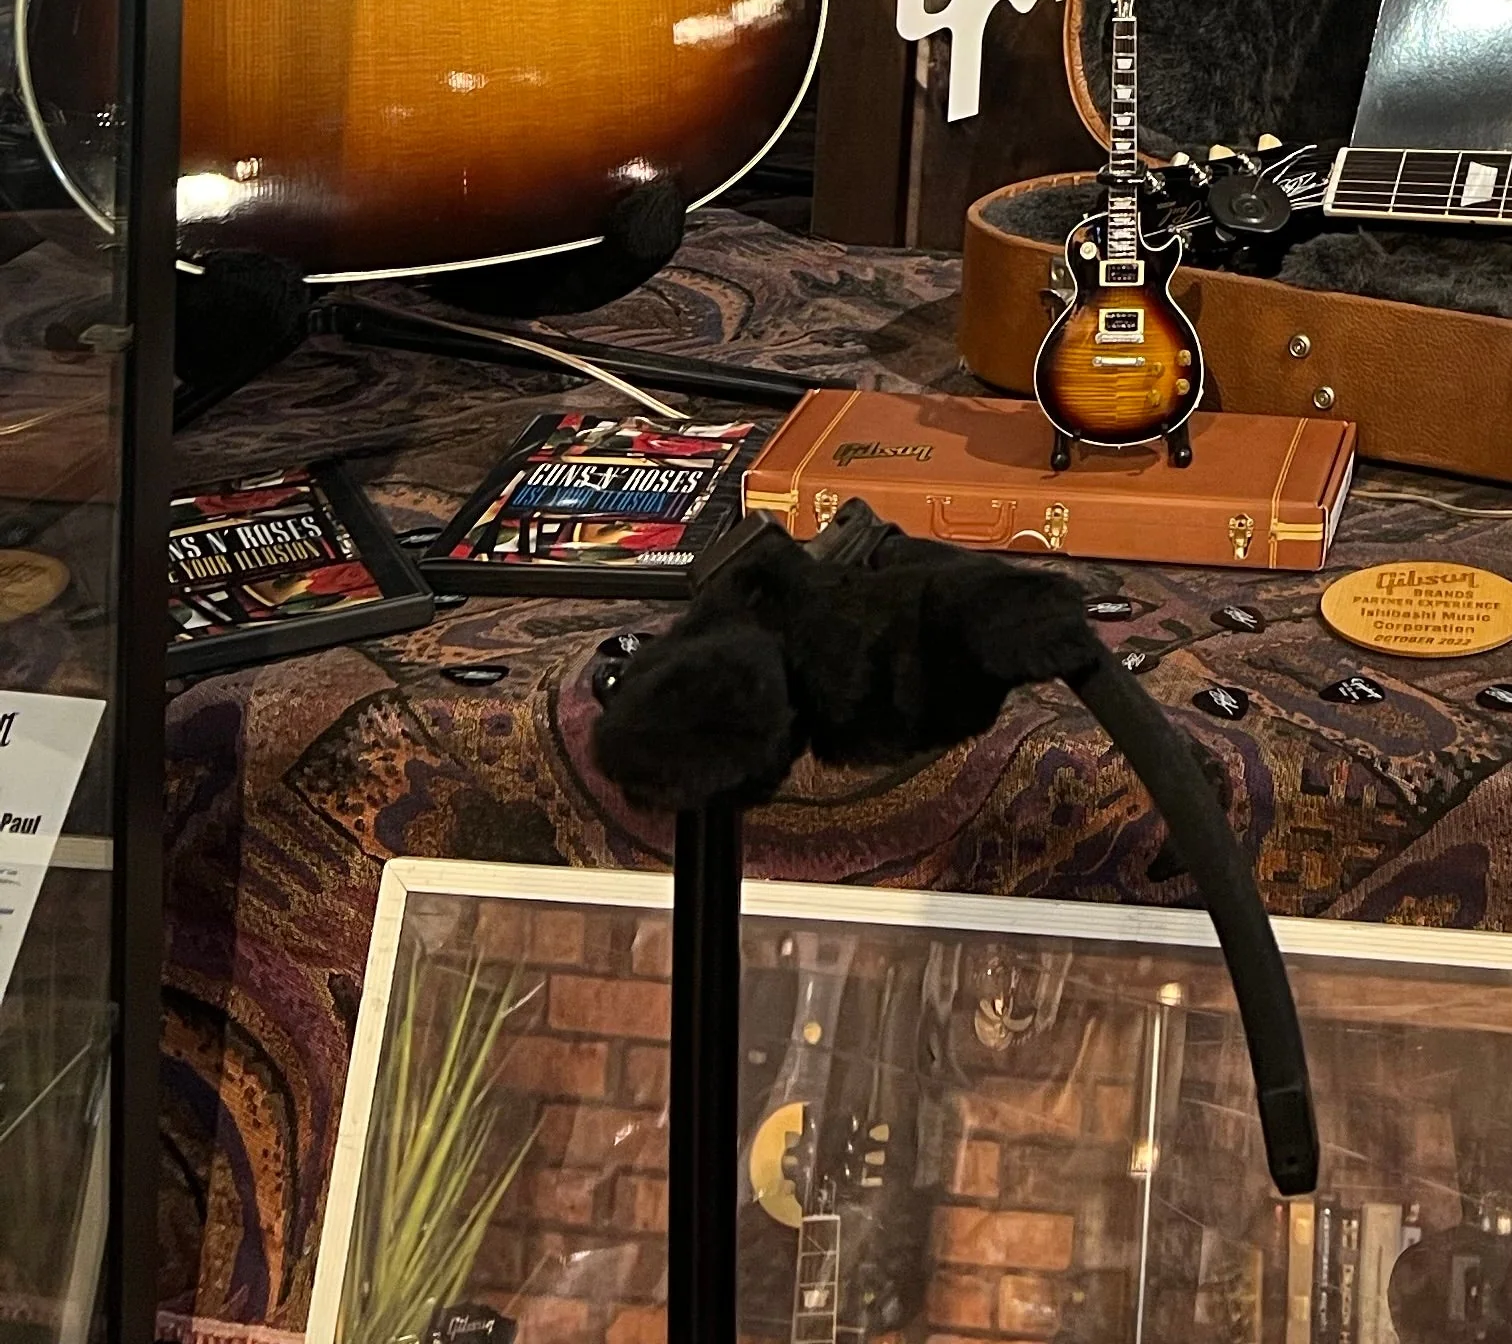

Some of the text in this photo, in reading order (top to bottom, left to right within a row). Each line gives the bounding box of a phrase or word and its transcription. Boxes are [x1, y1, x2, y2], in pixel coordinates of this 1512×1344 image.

[833, 442, 935, 467] Gibson
[527, 463, 597, 488] GUNS
[622, 468, 704, 494] ROSES
[236, 515, 323, 549] ROSES
[180, 554, 233, 580] YOUR
[233, 539, 321, 571] ILLUSION
[1376, 570, 1480, 595] Gibson
[1413, 588, 1474, 599] BRANDS
[1352, 596, 1501, 610] PARTNER EXPERIENCE
[1360, 607, 1491, 622] Ishibashi Music
[1373, 620, 1475, 634] Corporation
[1373, 634, 1434, 645] OCTOBER
[0, 813, 42, 835] Paul
